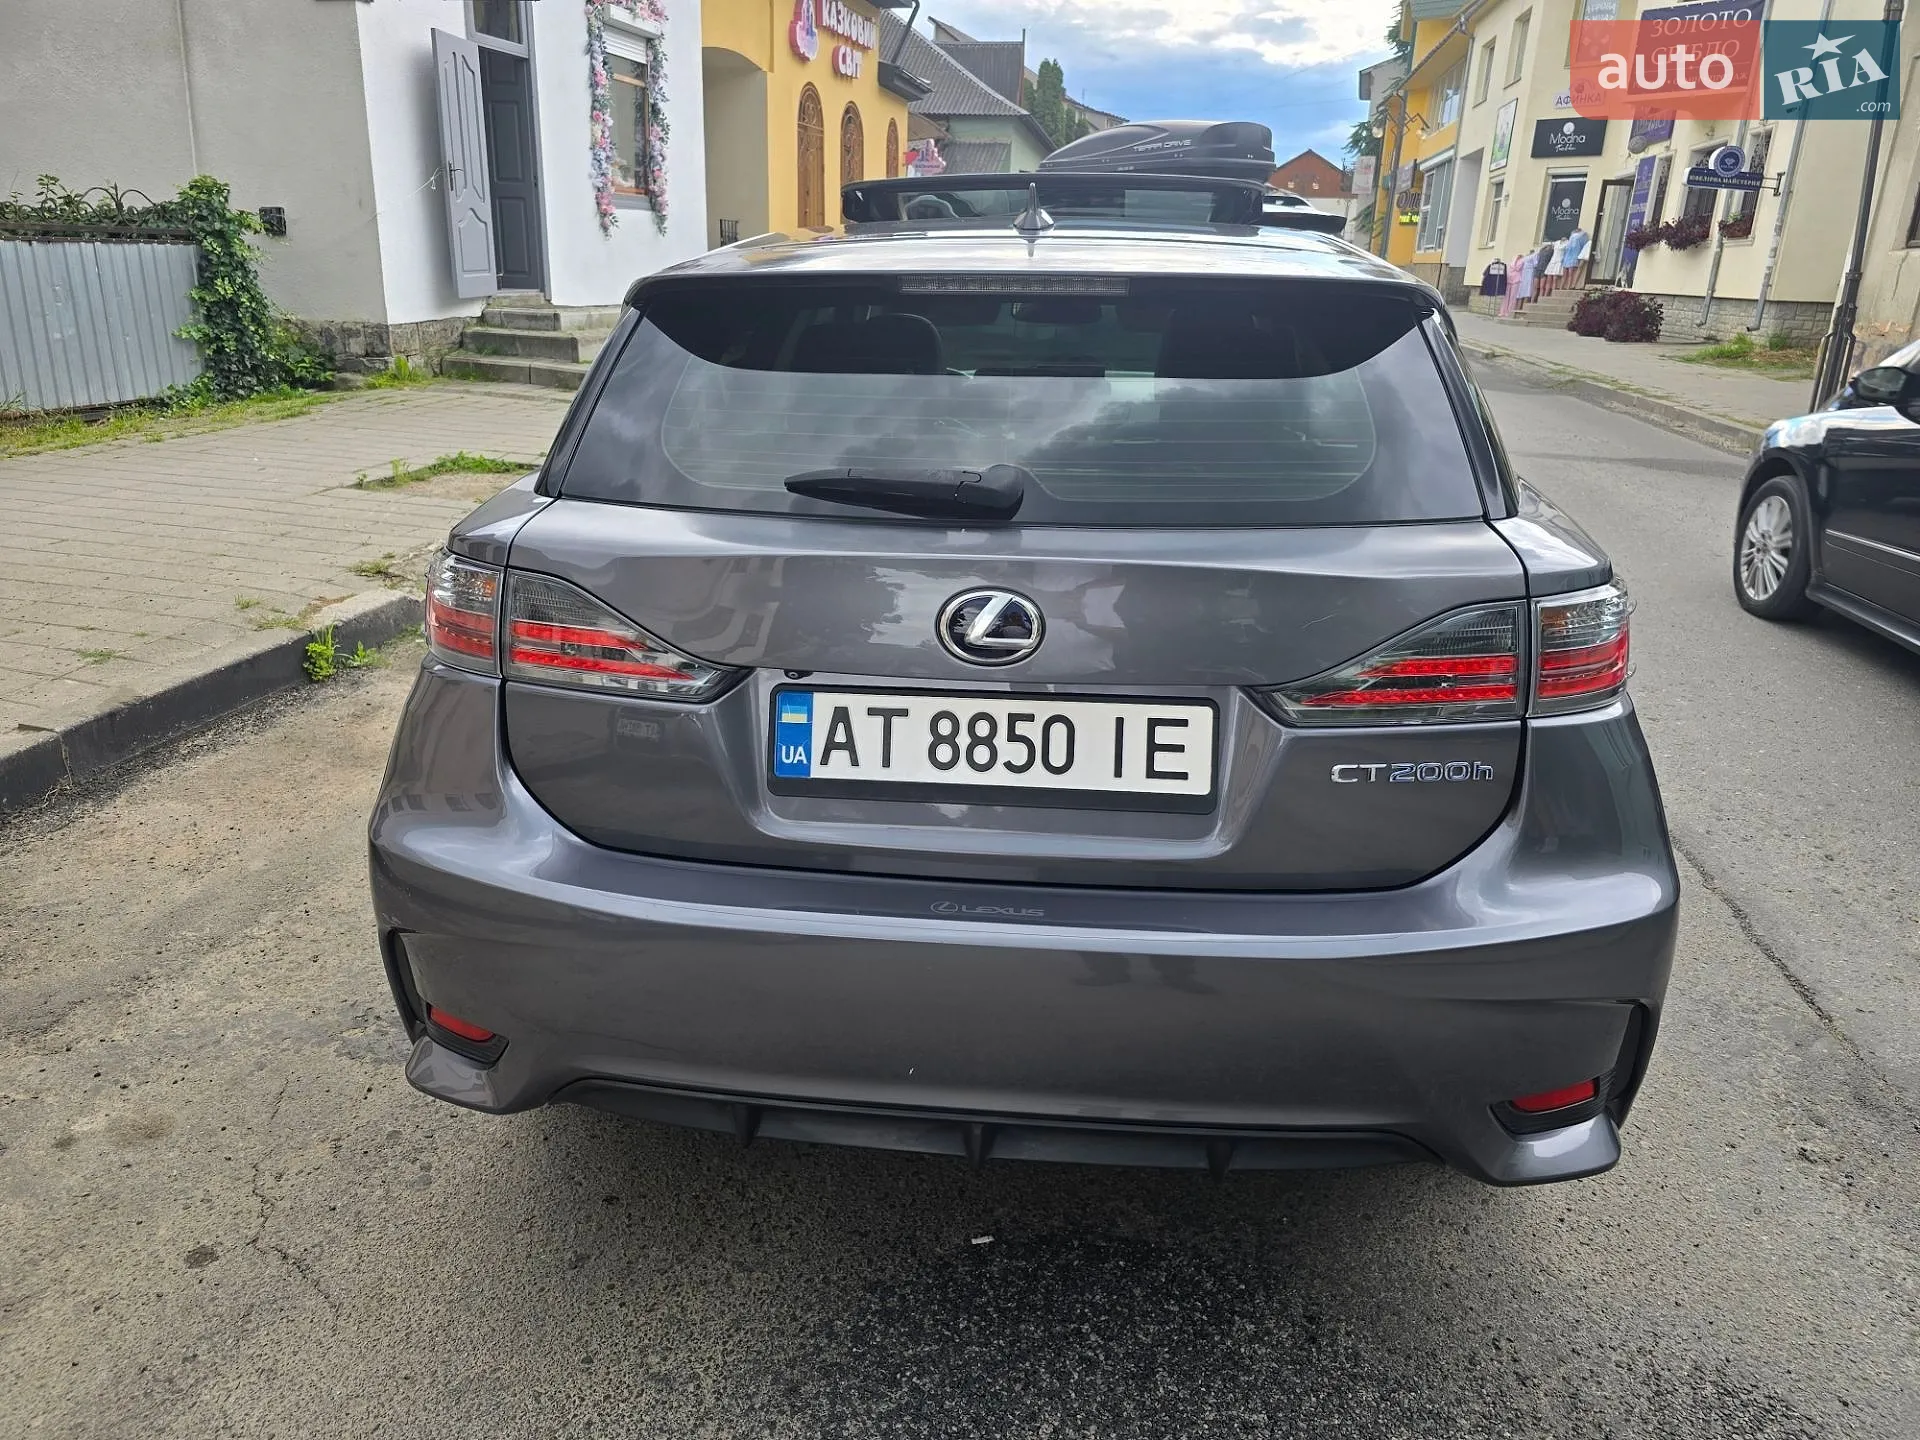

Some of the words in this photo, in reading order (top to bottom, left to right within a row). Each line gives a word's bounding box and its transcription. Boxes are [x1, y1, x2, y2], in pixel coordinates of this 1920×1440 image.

[822, 0, 877, 50] КАЗКОВИЙ
[1650, 8, 1753, 38] ЗОЛОТО
[838, 45, 863, 79] СВІТ
[1549, 132, 1586, 145] Modna
[781, 744, 809, 765] UA
[819, 705, 909, 768] AT
[927, 710, 1076, 776] 8850
[1113, 715, 1190, 781] IE
[961, 904, 1046, 917] LEXUS
